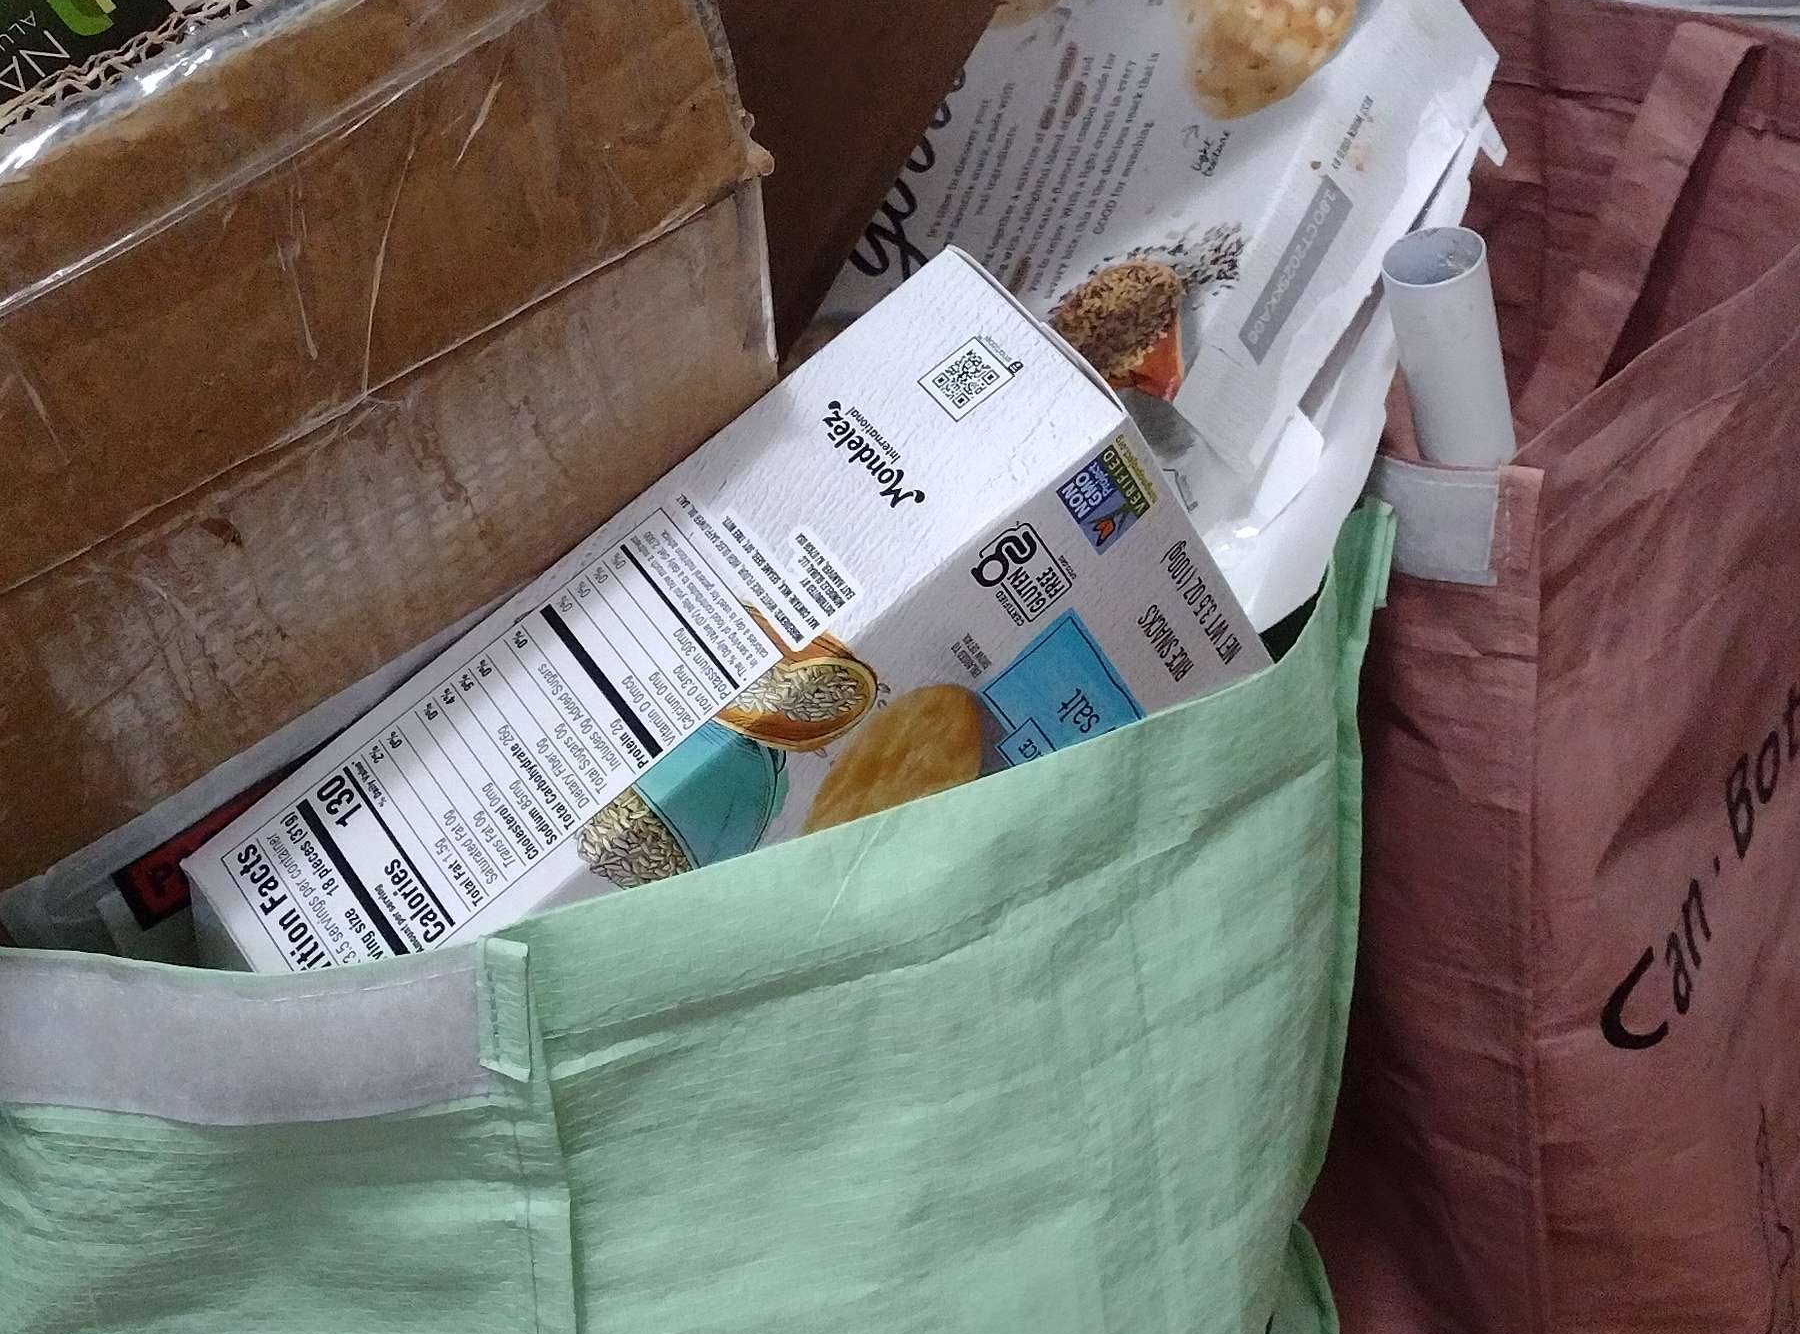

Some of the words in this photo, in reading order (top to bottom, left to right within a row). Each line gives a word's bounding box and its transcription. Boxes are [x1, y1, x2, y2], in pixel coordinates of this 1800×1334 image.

[1091, 196, 1117, 236] GOOD
[844, 404, 901, 466] International
[1073, 469, 1103, 508] GMO
[1087, 457, 1116, 496] Project
[1101, 446, 1149, 515] VERIFIED
[1062, 480, 1091, 519] NON
[608, 551, 627, 570] 0%
[665, 556, 682, 574] daily
[673, 546, 696, 572] nutrition
[573, 579, 592, 599] 0%
[590, 565, 609, 585] 0%
[692, 567, 715, 592] general
[1006, 564, 1047, 616] GLUTEN
[1035, 565, 1065, 600] FREE
[1179, 575, 1209, 604] OZ
[555, 594, 573, 613] 0%
[684, 581, 715, 615] contributes
[715, 597, 732, 614] used
[994, 587, 1025, 630] CERTIFIED
[701, 622, 720, 643] Value
[709, 611, 725, 628] food
[732, 616, 747, 632] day
[1134, 602, 1182, 658] SNACKS
[1201, 614, 1232, 643] WT
[510, 629, 529, 649] 0%
[670, 626, 698, 657] 30mg
[714, 637, 733, 658] Daily
[726, 631, 750, 657] serving
[744, 632, 769, 659] calories
[1213, 632, 1246, 664] NET
[474, 658, 493, 678] 0%
[534, 660, 566, 696] Sugars
[689, 651, 732, 700] Potassium
[1161, 645, 1197, 682] RICE
[456, 672, 475, 692] 9%
[619, 673, 647, 704] 0mcg
[645, 670, 670, 696] 0mg
[669, 663, 700, 697] 0.3mg
[421, 701, 439, 721] 0%
[439, 686, 457, 706] 4%
[556, 691, 584, 723] Added
[660, 691, 696, 731] Calcium
[691, 691, 714, 715] Iron
[576, 716, 595, 735] 0g
[607, 716, 626, 736] 2g
[644, 707, 677, 746] Vitamin
[1050, 685, 1103, 740] salt
[384, 729, 403, 750] 0%
[495, 723, 516, 746] 26g
[532, 736, 551, 755] 0g
[551, 721, 569, 740] 0g
[366, 744, 385, 764] 2%
[542, 749, 566, 777] Fiber
[560, 733, 593, 771] Sugars
[586, 730, 621, 772] Includes
[616, 730, 649, 769] Protein
[507, 740, 559, 805] Carbohydrate
[583, 766, 609, 794] Total
[313, 772, 365, 830] 130
[365, 778, 384, 799] Daily
[480, 781, 503, 807] 0mg
[507, 778, 534, 810] 85mg
[558, 769, 592, 809] Dietary
[278, 810, 309, 845] (31g)
[440, 807, 459, 827] 0g
[470, 808, 489, 828] 0g
[525, 806, 558, 845] Sodium
[550, 800, 576, 830] Total
[449, 821, 467, 841] Fat
[479, 823, 497, 843] Fat
[493, 802, 540, 861] Cholesterol
[263, 830, 303, 881] container
[296, 837, 332, 881] pieces
[432, 836, 456, 863] 1.5g
[459, 836, 499, 885] Saturated
[489, 837, 516, 869] Trans
[228, 841, 289, 916] Facts
[446, 858, 466, 880] Fat
[294, 874, 316, 899] per
[320, 876, 340, 898] 18
[372, 882, 397, 913] serving
[377, 856, 447, 945] Calories
[459, 876, 485, 906] Total
[305, 892, 346, 945] servings
[340, 906, 366, 936] size
[271, 906, 332, 982] ition
[334, 939, 357, 964] 3.5
[357, 929, 387, 963] ving
[399, 923, 425, 955] Amount
[1601, 878, 1711, 1049] Can
